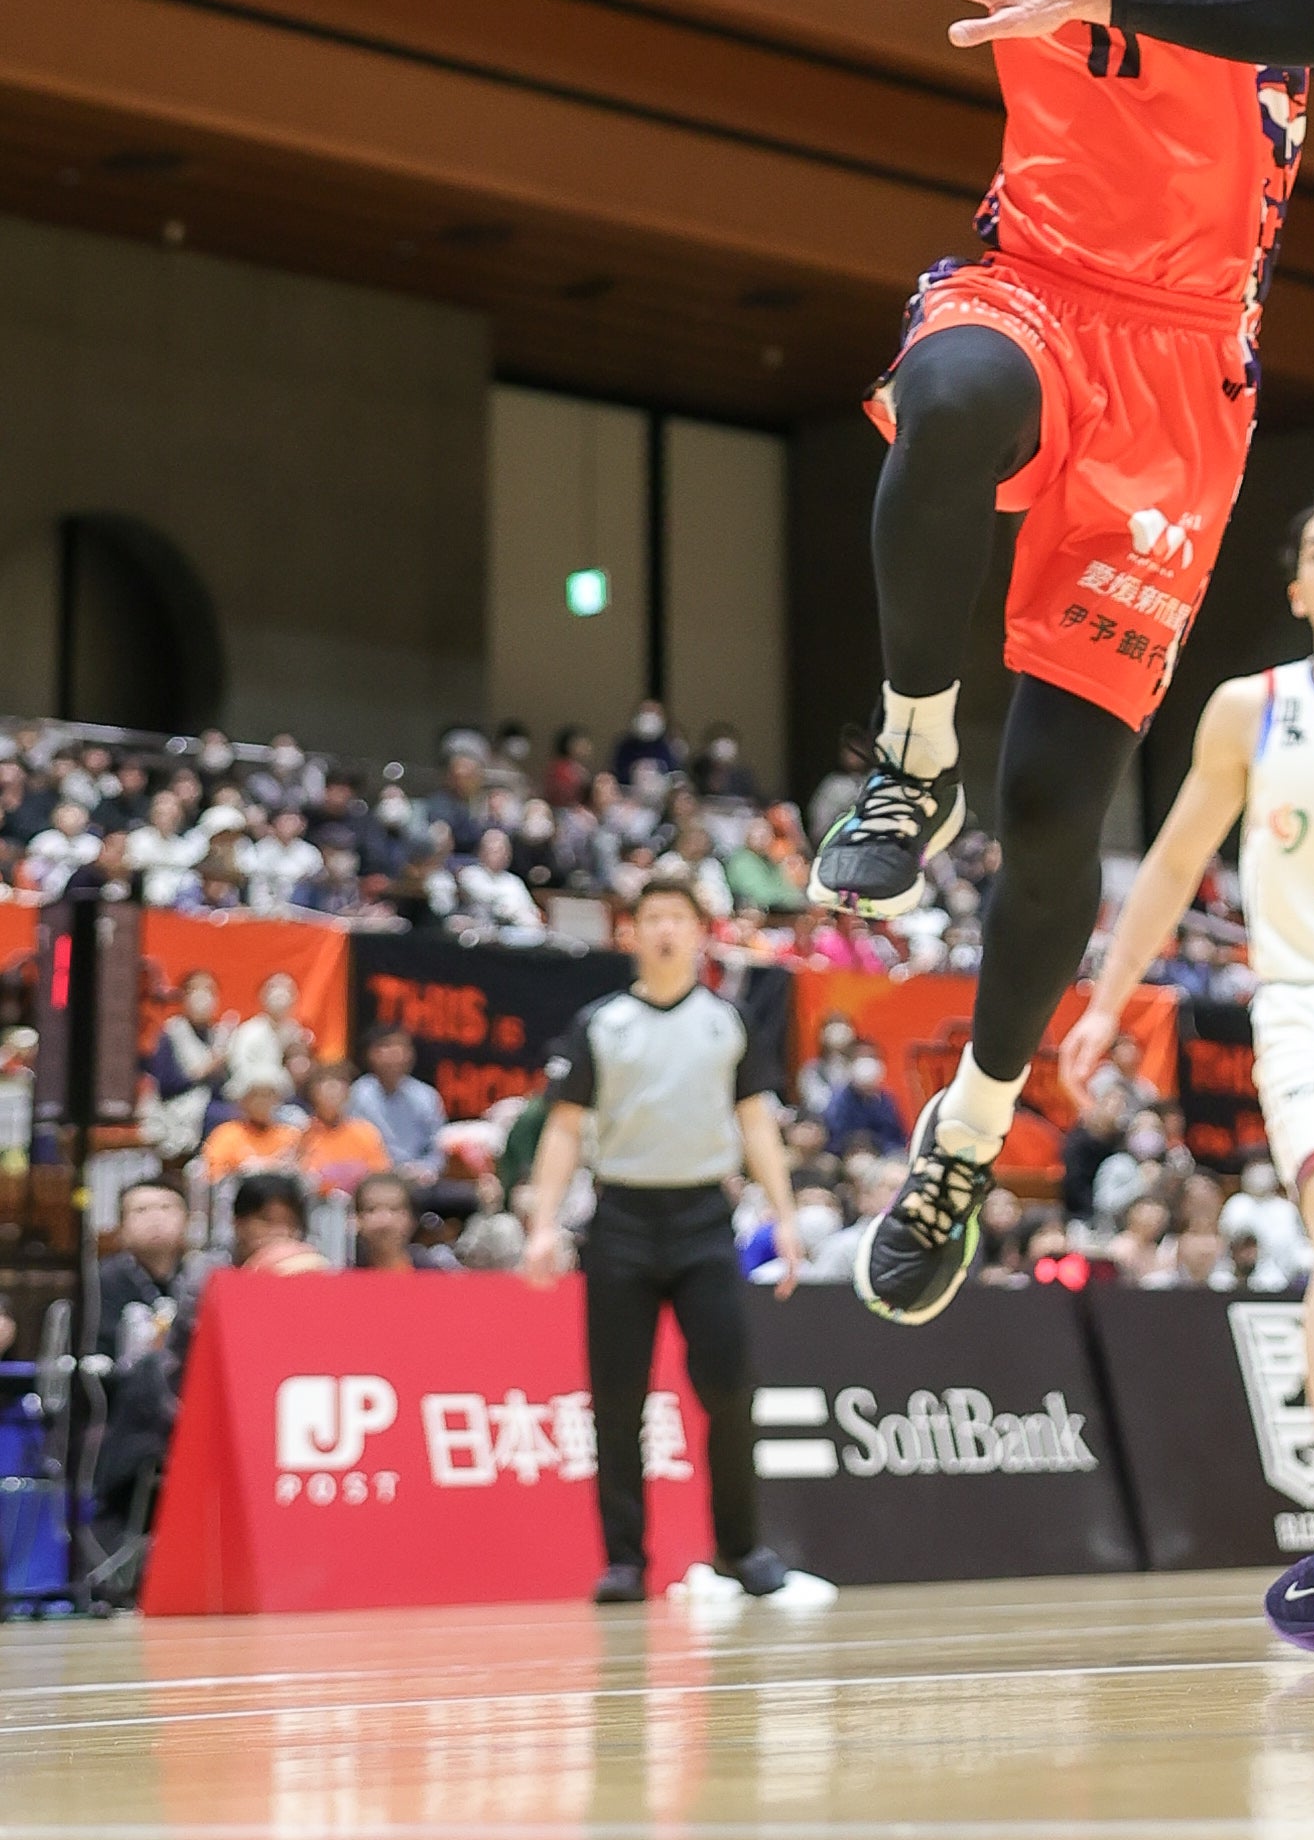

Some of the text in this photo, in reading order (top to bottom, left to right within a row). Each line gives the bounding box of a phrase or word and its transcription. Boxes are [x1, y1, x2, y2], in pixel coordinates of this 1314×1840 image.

[367, 973, 487, 1046] THIS
[834, 1386, 1099, 1477] SoftBank
[275, 1471, 399, 1506] POST
